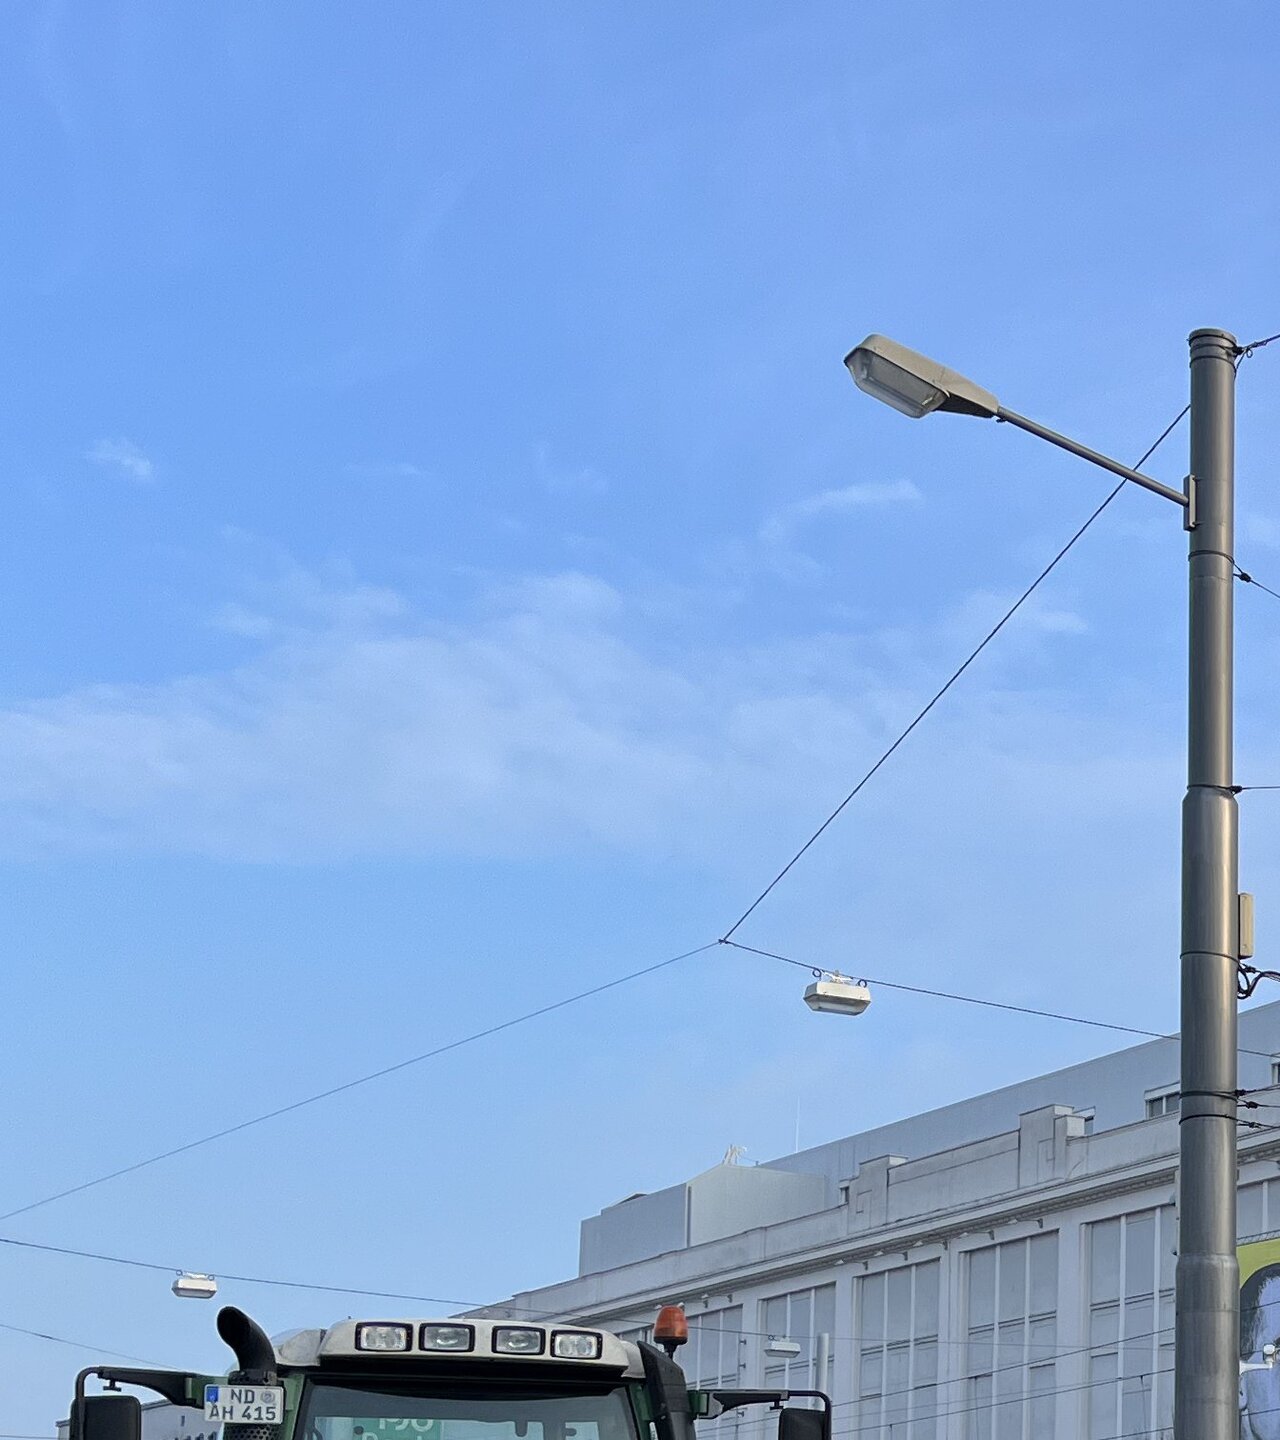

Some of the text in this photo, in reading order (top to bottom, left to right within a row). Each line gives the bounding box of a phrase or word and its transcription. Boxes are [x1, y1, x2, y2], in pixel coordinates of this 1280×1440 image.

[230, 1388, 255, 1404] ND
[209, 1405, 277, 1421] AH 415
